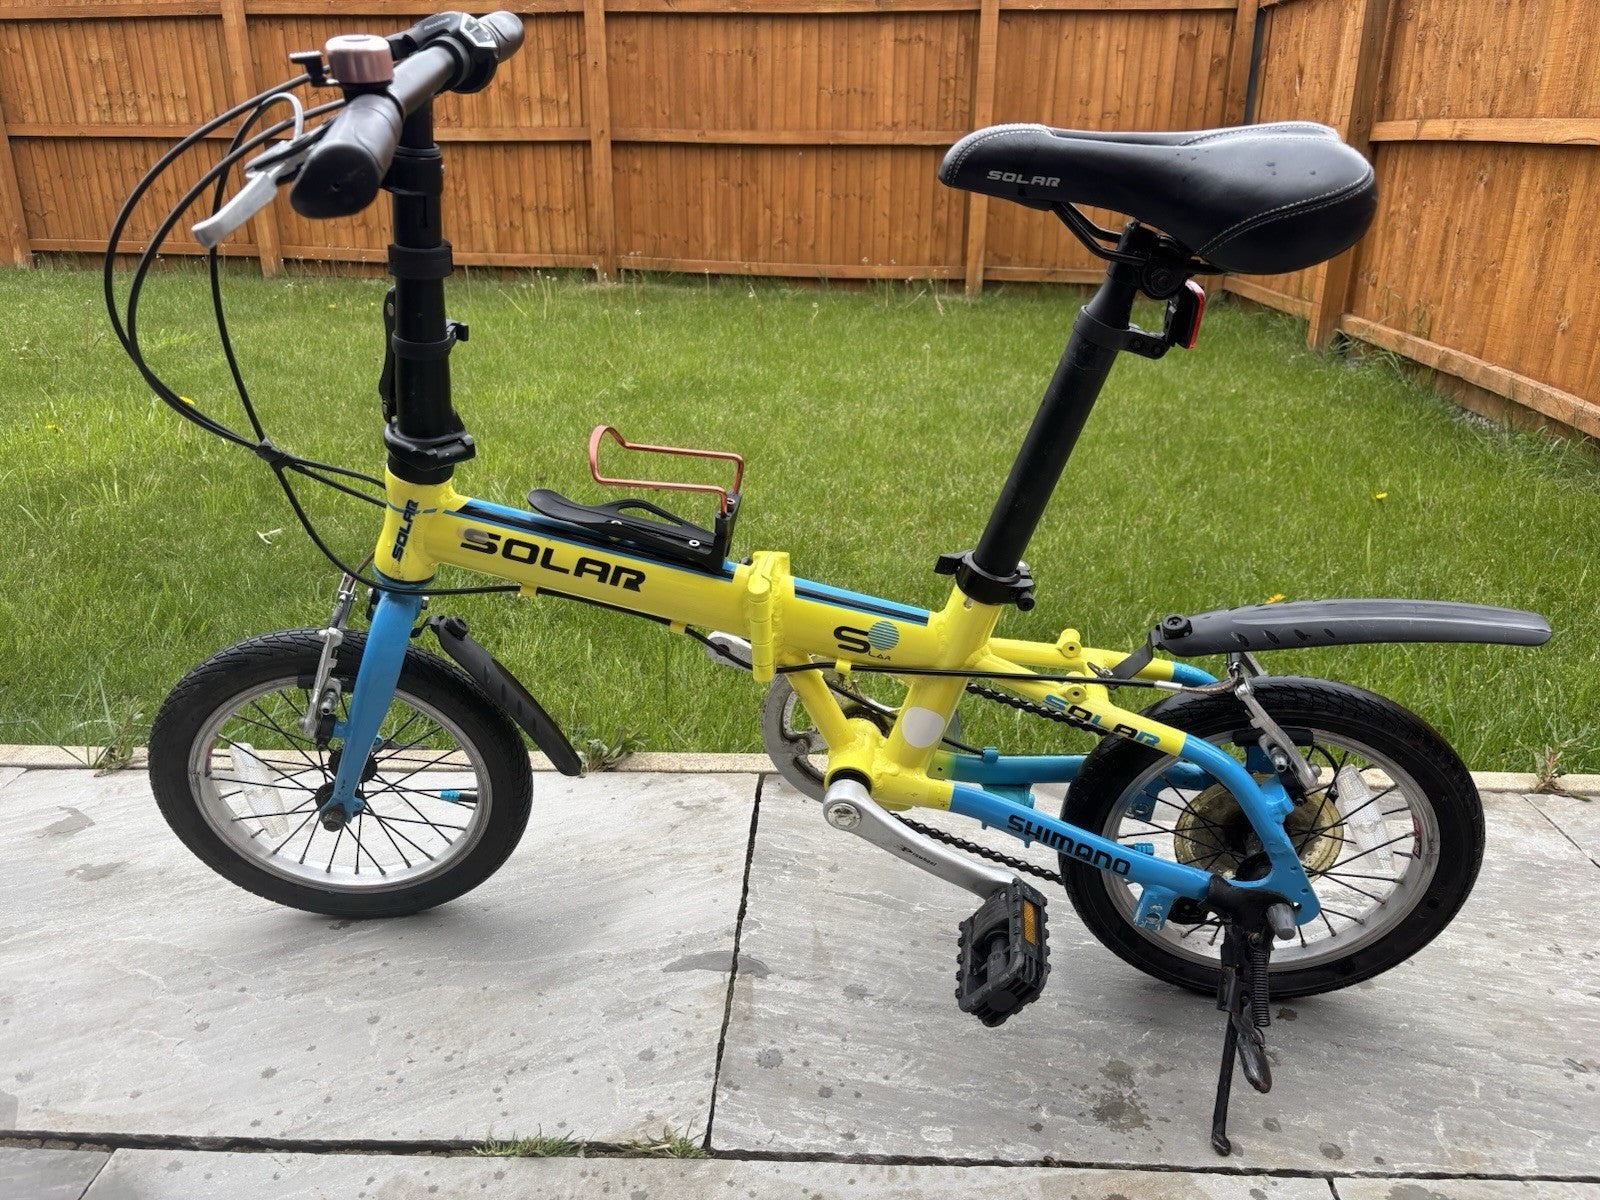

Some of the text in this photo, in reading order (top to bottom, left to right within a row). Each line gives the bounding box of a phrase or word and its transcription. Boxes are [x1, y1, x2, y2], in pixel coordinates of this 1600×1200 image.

[987, 170, 1060, 187] SOLAR
[392, 499, 419, 562] SOLAR
[460, 527, 646, 593] SOLAR
[1044, 694, 1161, 747] SOLAR
